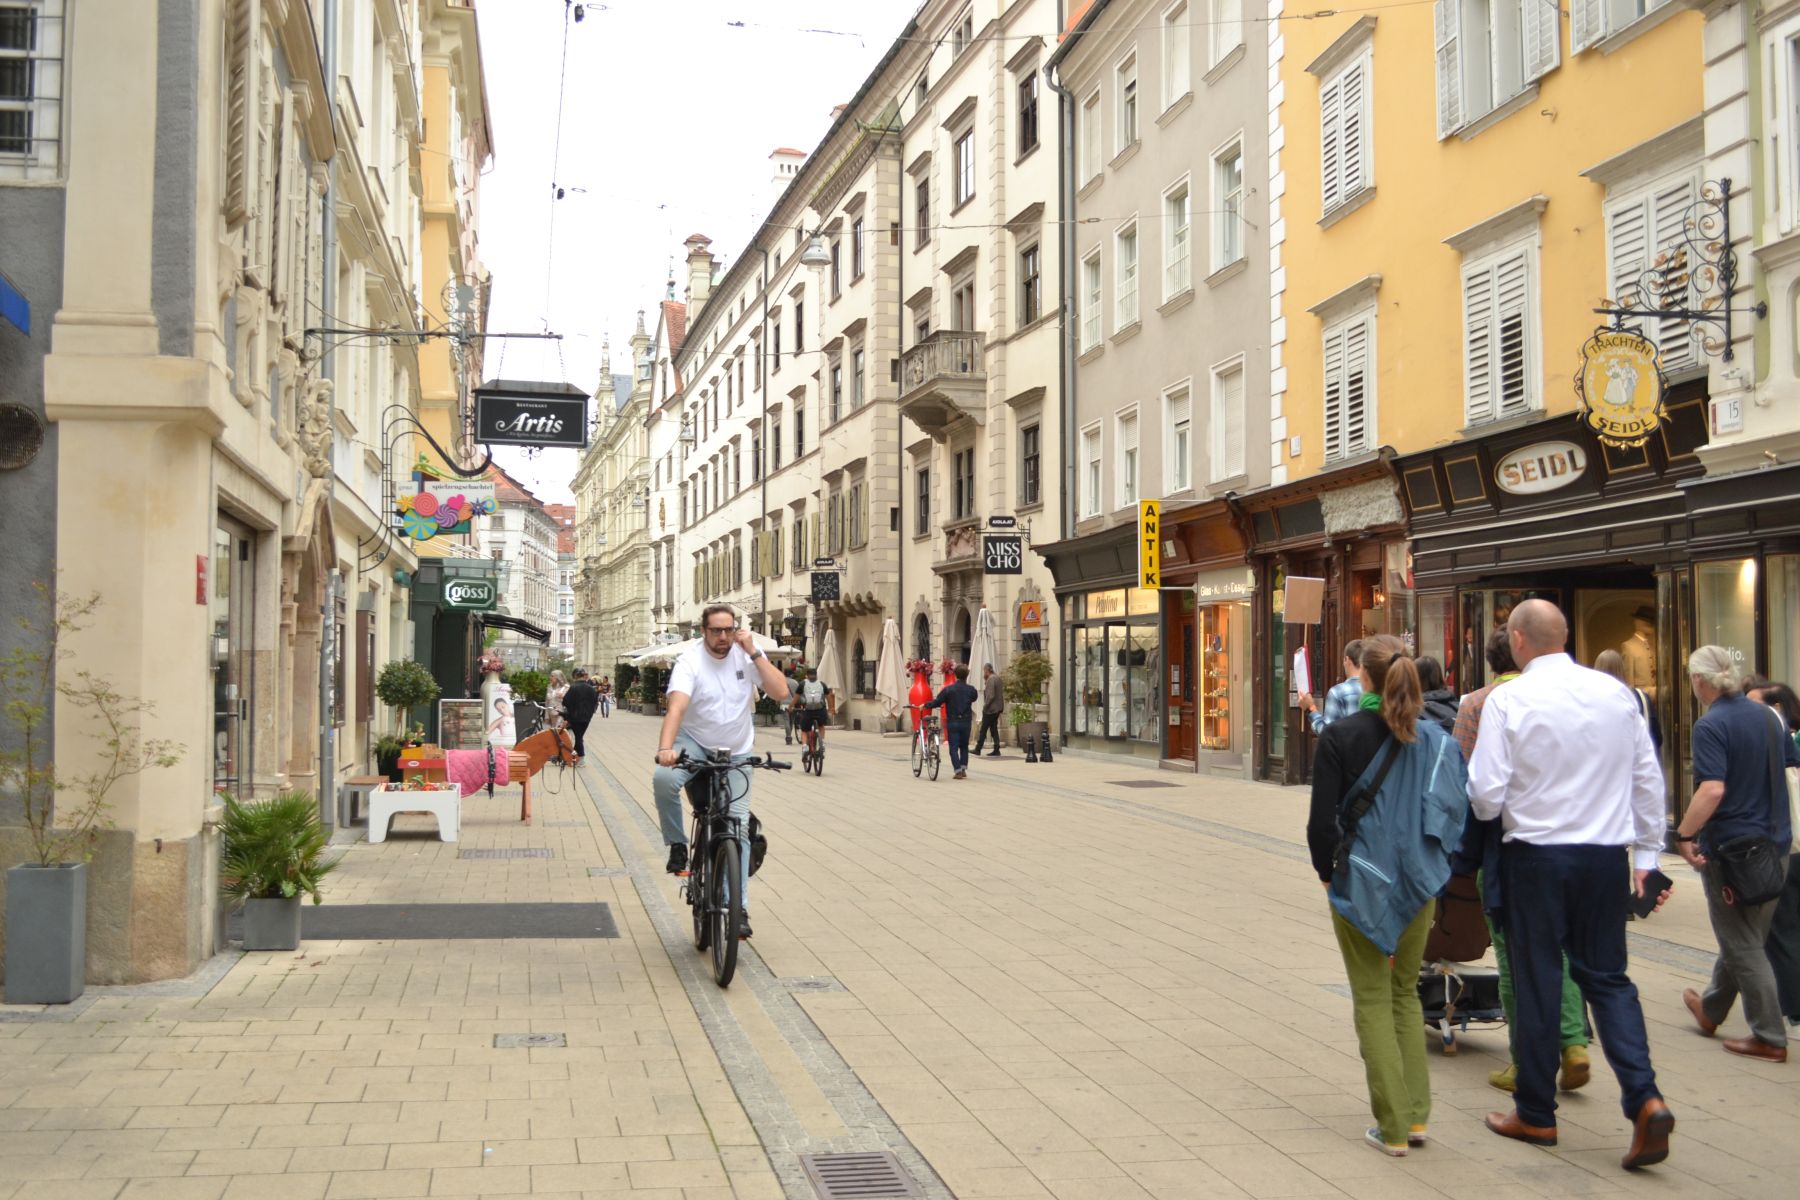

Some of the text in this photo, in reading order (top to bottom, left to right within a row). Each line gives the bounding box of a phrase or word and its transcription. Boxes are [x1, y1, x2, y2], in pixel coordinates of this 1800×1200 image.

[1589, 337, 1651, 356] TRACHTEN
[1729, 401, 1739, 419] 15
[495, 412, 564, 433] Artis
[1596, 417, 1652, 434] SEIDL
[1503, 449, 1585, 486] SEIDL
[987, 542, 1020, 555] MISS
[1145, 505, 1157, 585] ANTIK
[986, 555, 1020, 569] CHO
[451, 585, 489, 602] gössl
